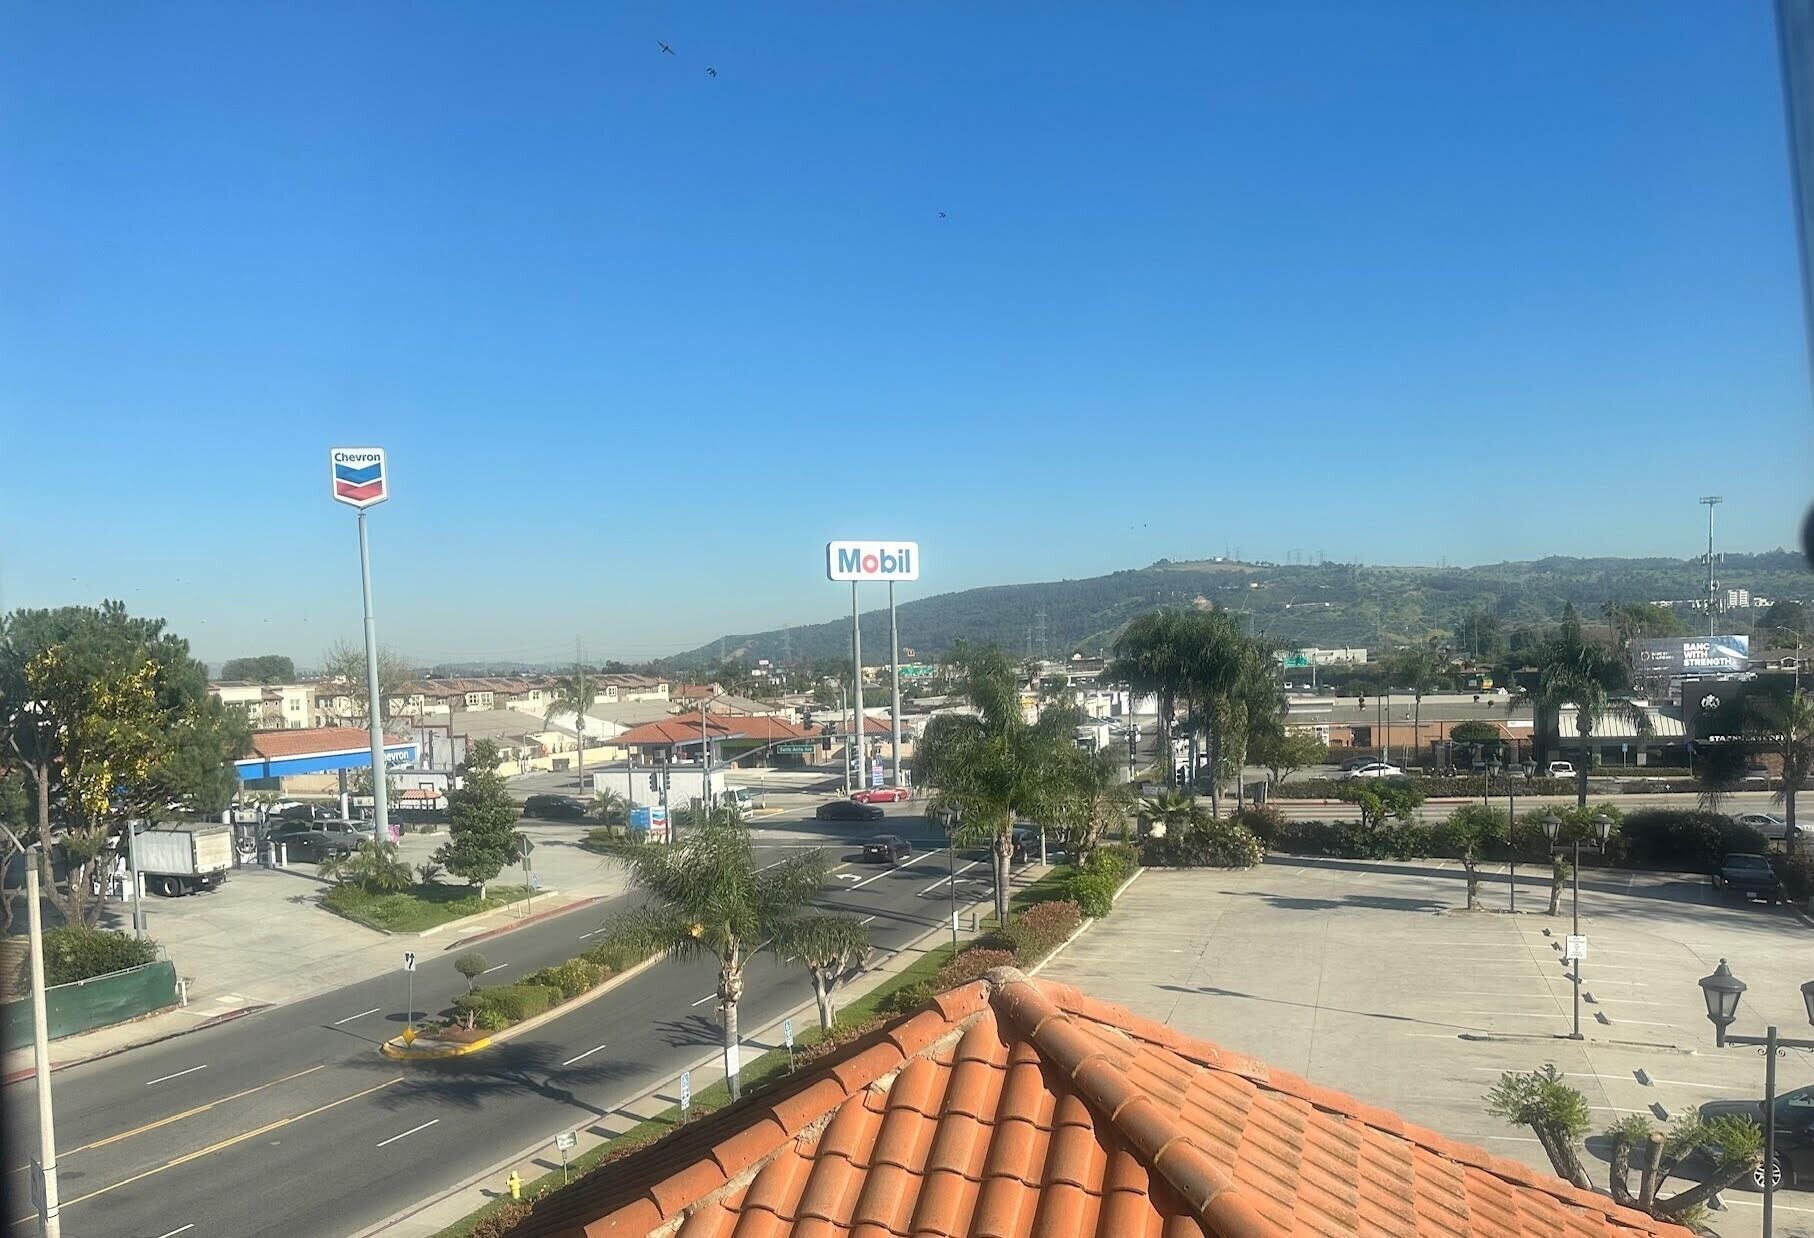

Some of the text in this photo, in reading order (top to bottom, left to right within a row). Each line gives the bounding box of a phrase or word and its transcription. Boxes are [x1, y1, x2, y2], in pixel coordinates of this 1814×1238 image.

[334, 452, 381, 462] Chevron
[838, 547, 911, 574] Mobil
[1683, 642, 1711, 652] BANC
[1683, 650, 1708, 660] WITH
[1683, 657, 1732, 667] STRENGTH
[384, 751, 409, 761] evron
